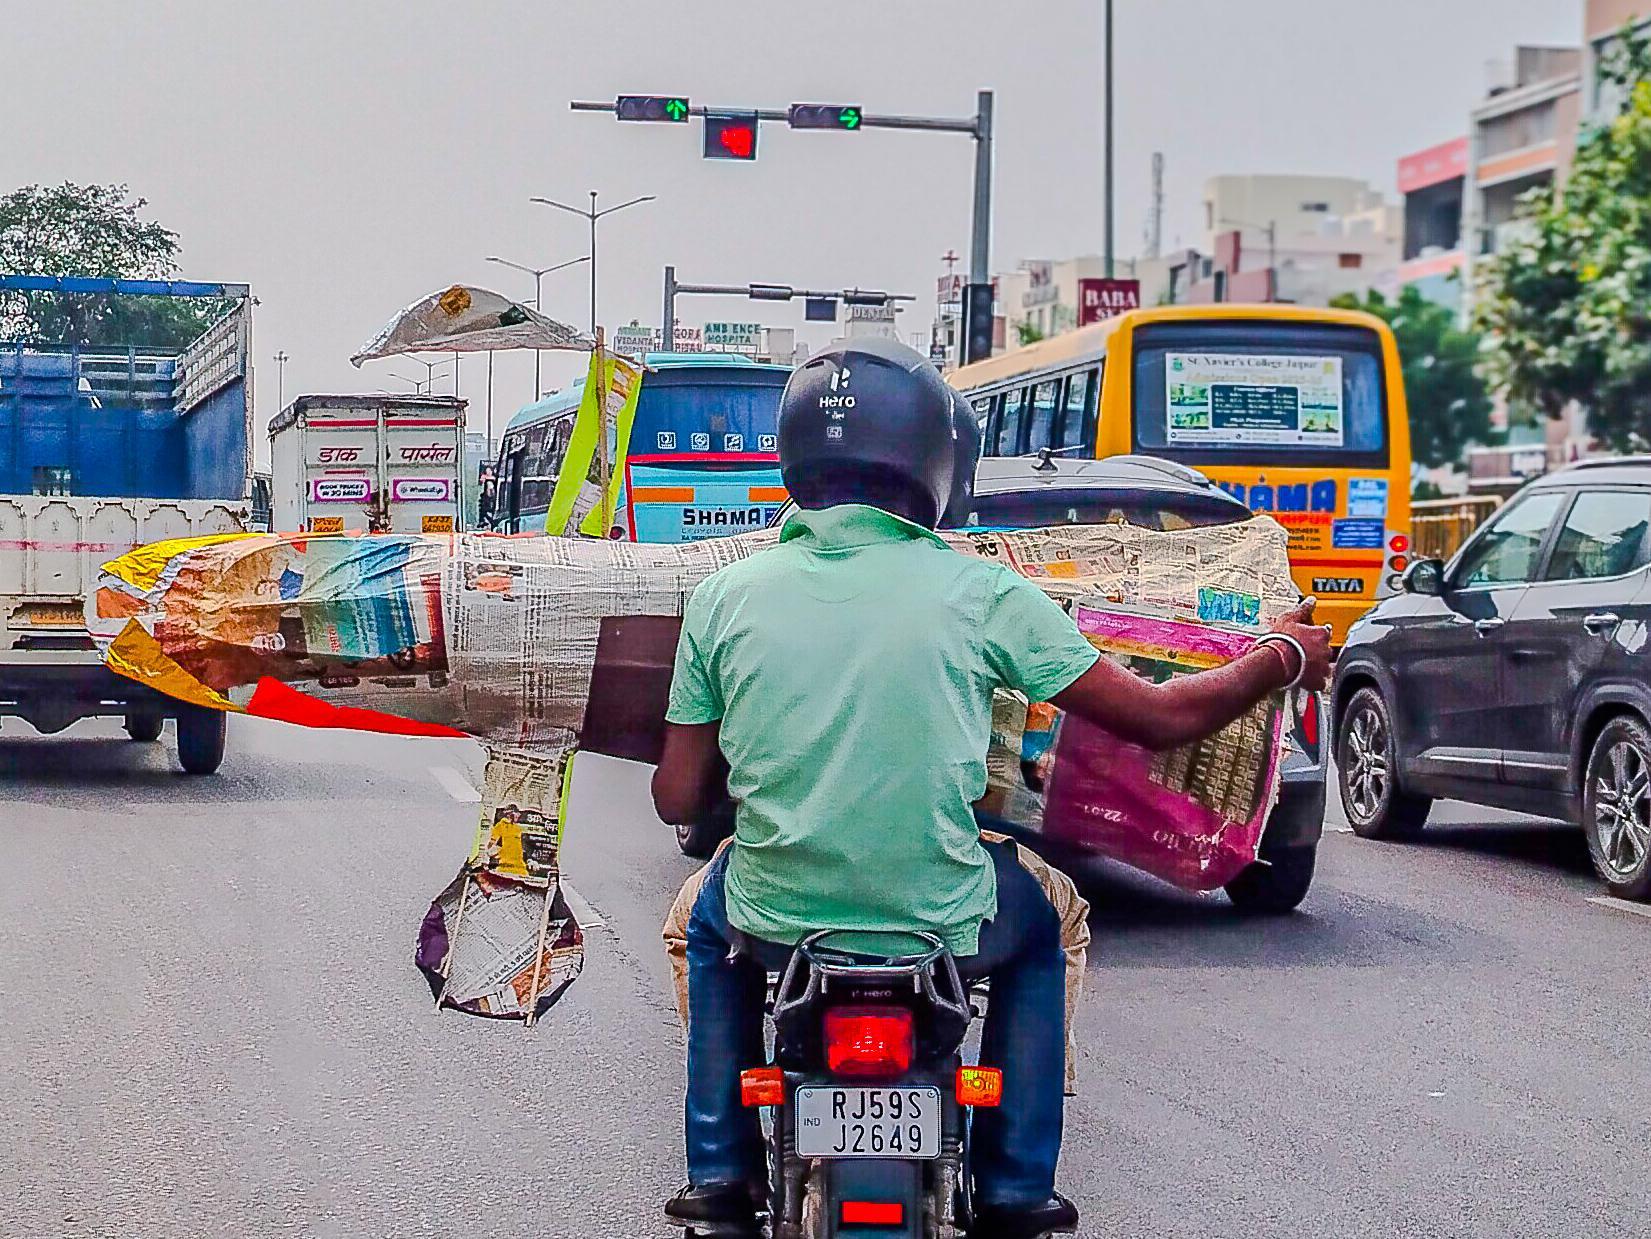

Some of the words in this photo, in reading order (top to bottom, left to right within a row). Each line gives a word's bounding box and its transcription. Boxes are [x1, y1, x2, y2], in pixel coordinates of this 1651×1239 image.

[1085, 289, 1136, 307] BABA
[705, 323, 761, 334] AMBENCE
[819, 396, 856, 408] Hero
[318, 447, 364, 463] डाक
[400, 443, 455, 463] पार्सल
[1209, 475, 1336, 513] HAMA
[682, 507, 761, 526] SHAMA
[1313, 577, 1362, 593] TATA
[832, 1090, 922, 1120] RJ59S
[803, 1117, 821, 1127] IND
[832, 1124, 923, 1153] J2649
